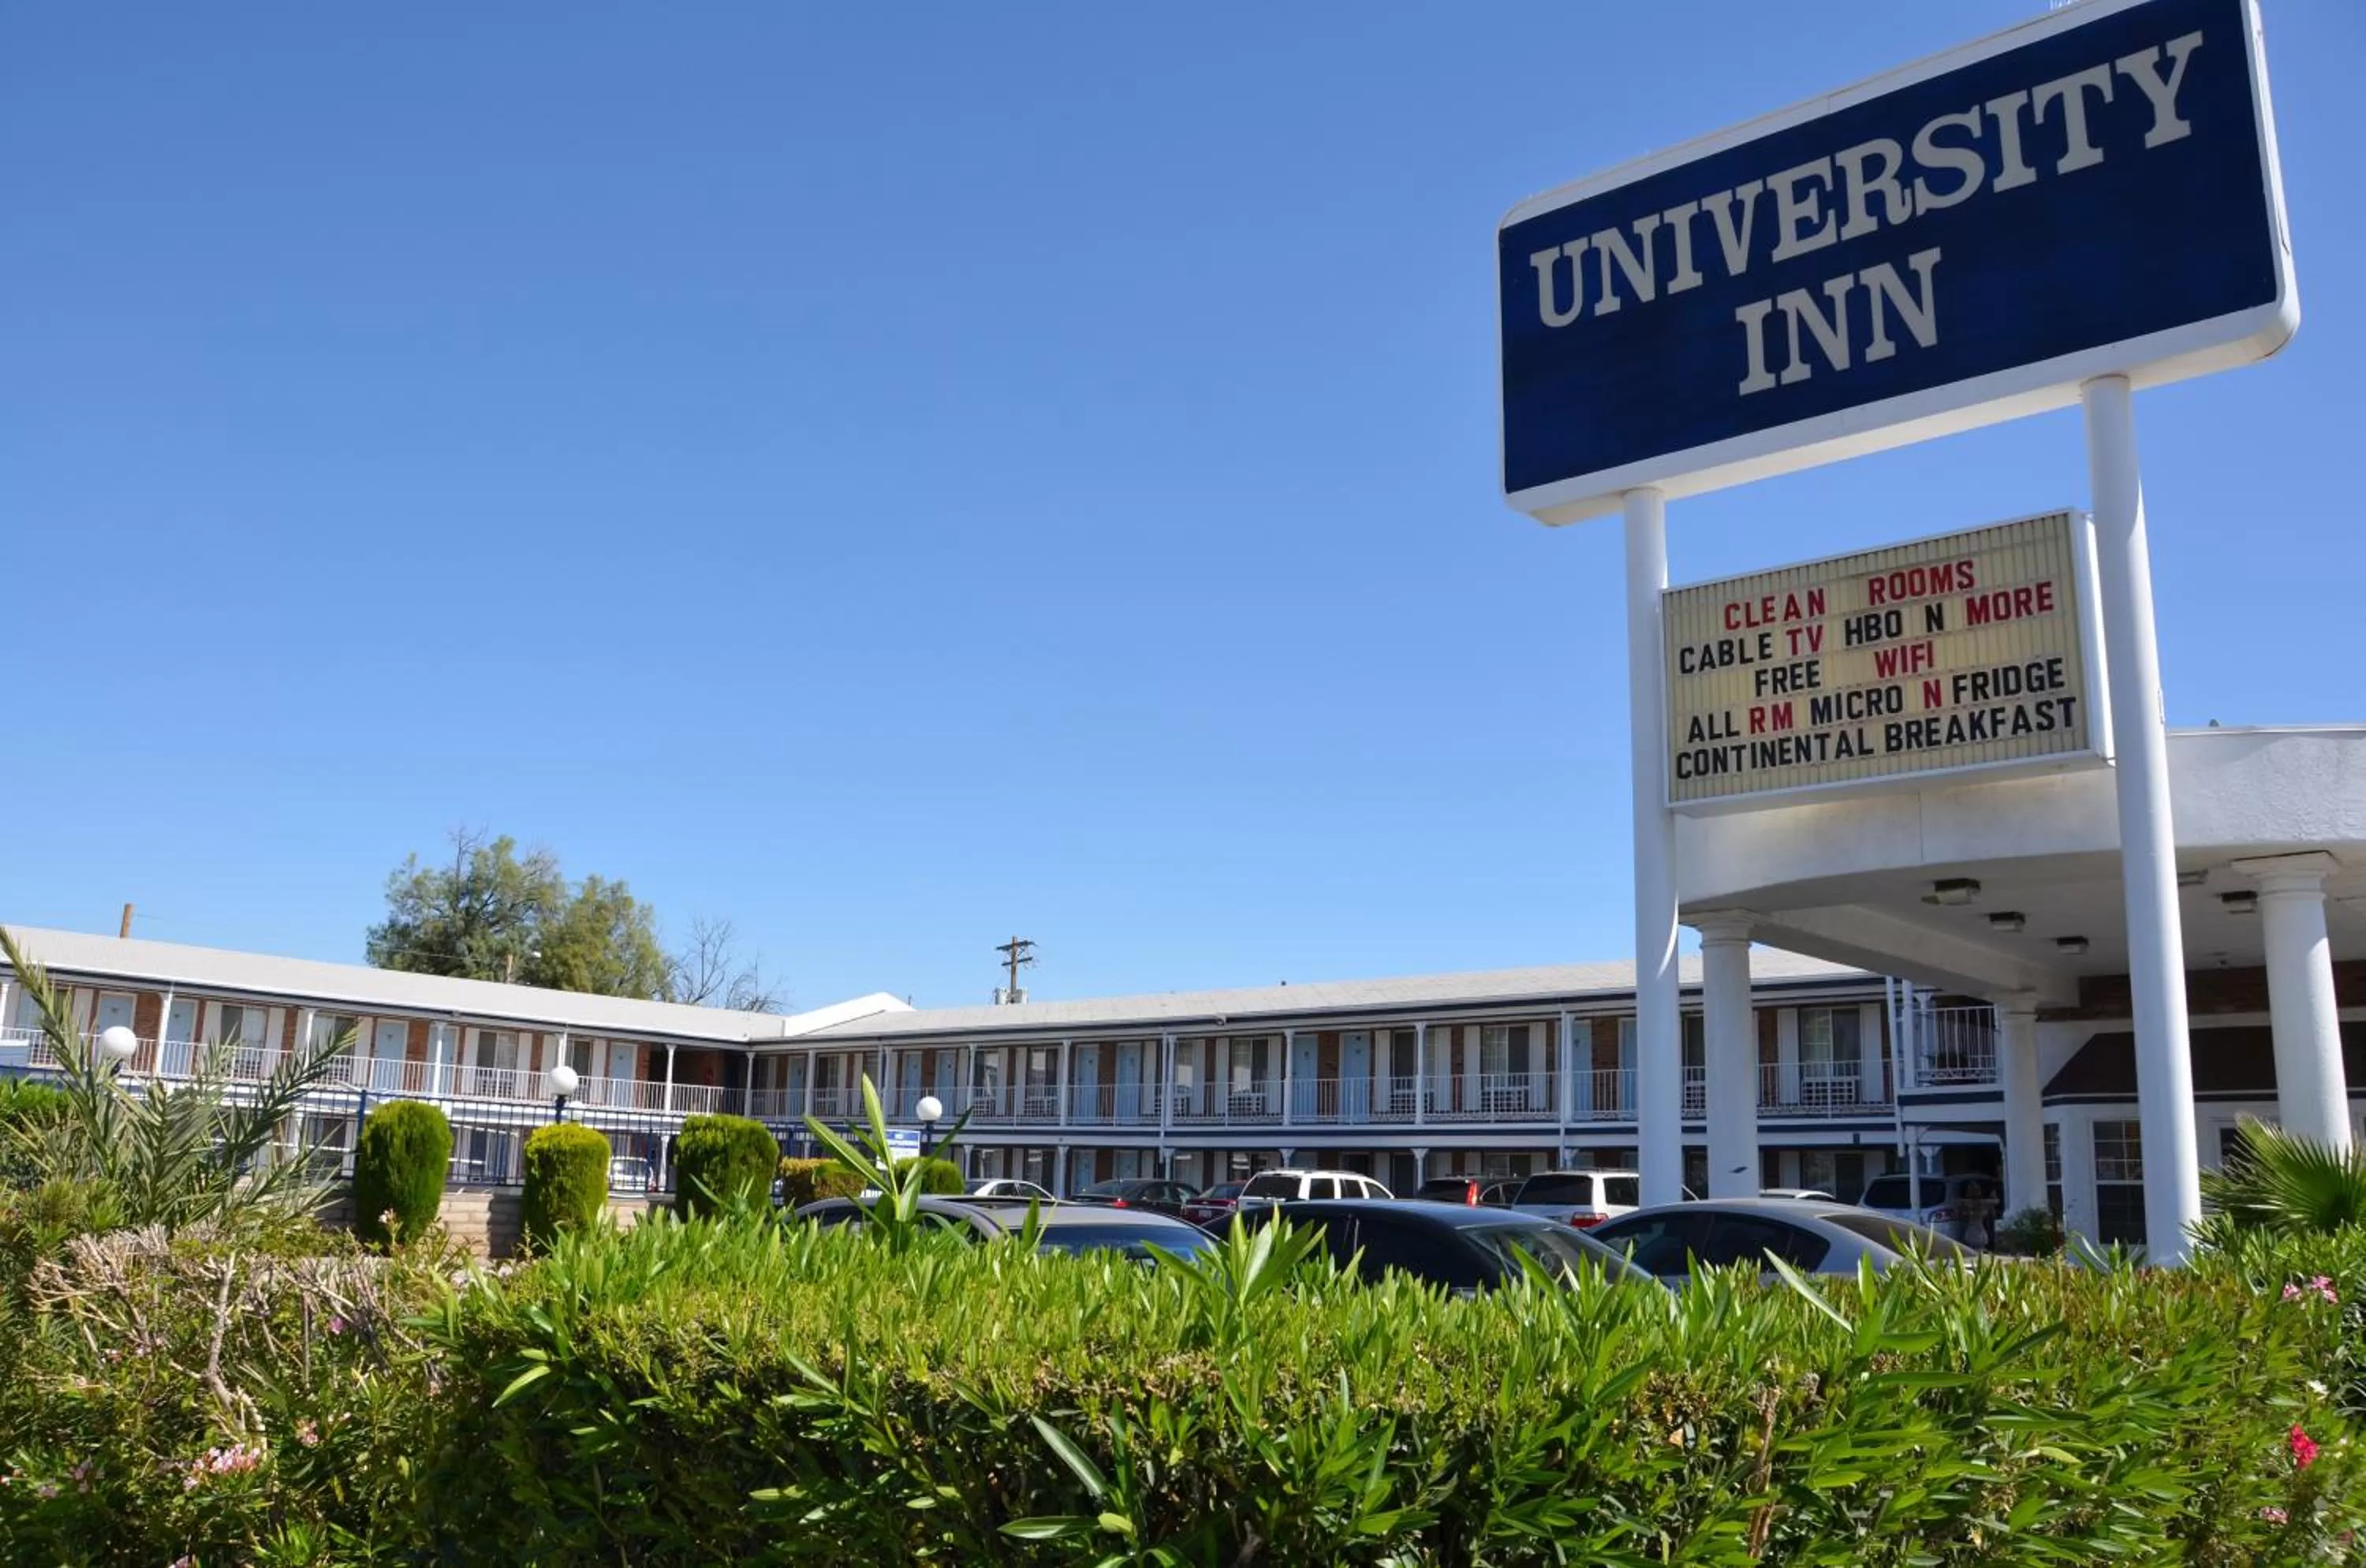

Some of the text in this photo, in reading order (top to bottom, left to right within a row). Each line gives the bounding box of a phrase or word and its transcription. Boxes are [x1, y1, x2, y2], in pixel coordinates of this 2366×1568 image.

[1529, 30, 2204, 328] UNIVERSITY
[1736, 247, 1942, 397] INN
[1679, 581, 2054, 675] CABLE TV HBO N MORE
[1725, 560, 1975, 631] CLEAN ROOMS
[1687, 657, 2065, 744] ALL RM MICRO N FRIDGE
[1755, 640, 1935, 697] FREE WIFI
[1676, 696, 2077, 780] CONTINENTAL BREAKFAST
